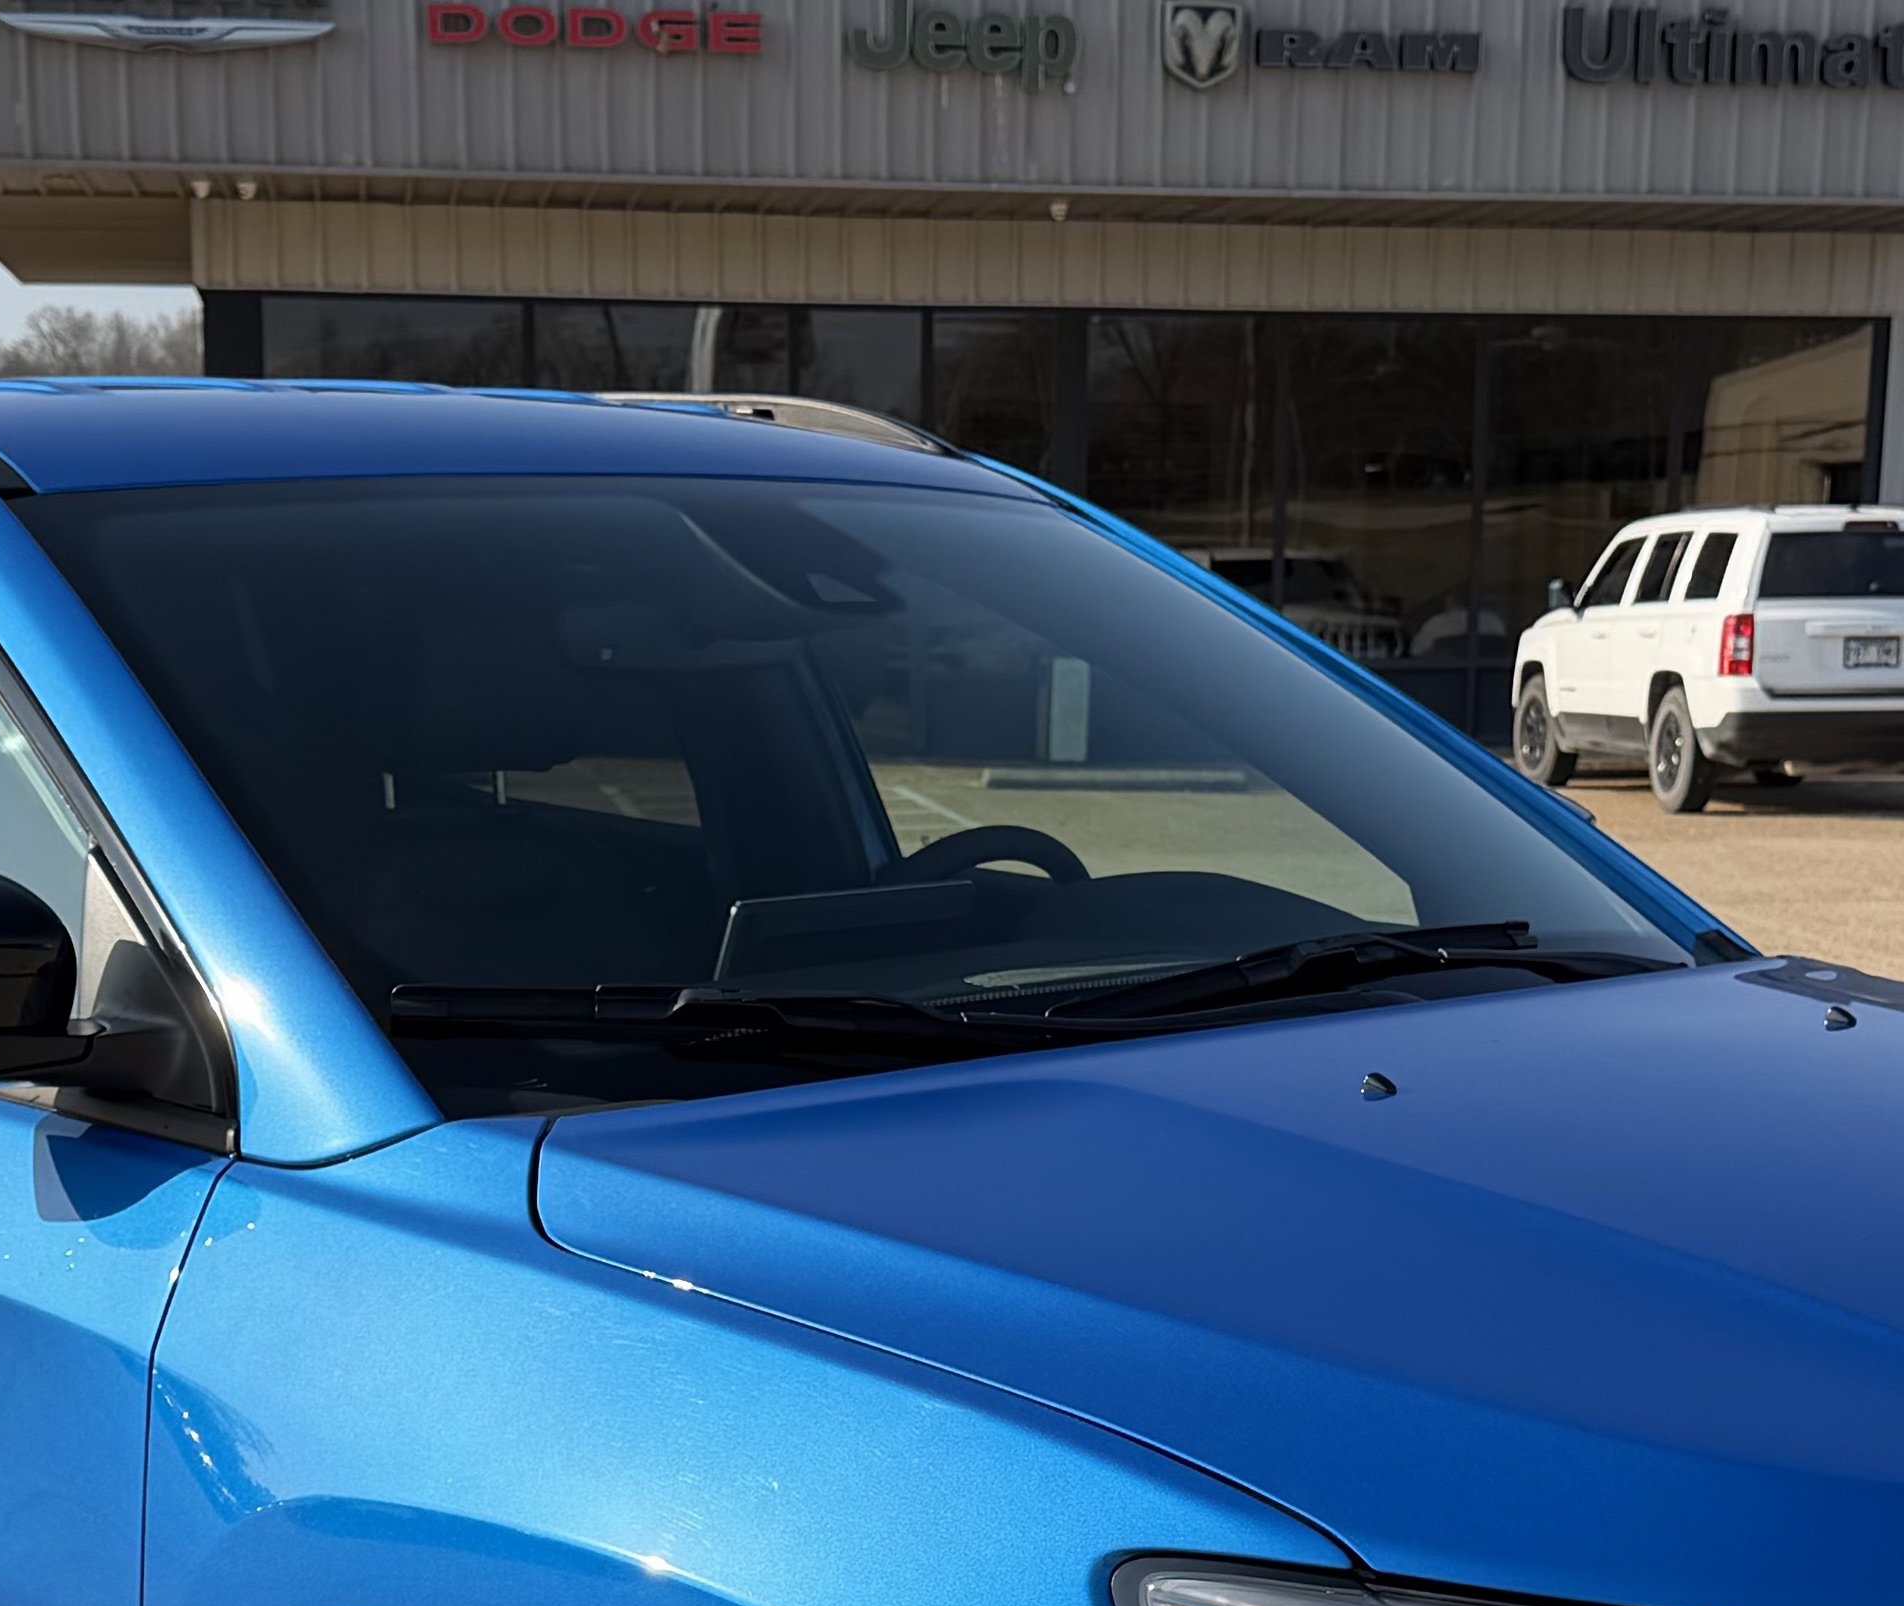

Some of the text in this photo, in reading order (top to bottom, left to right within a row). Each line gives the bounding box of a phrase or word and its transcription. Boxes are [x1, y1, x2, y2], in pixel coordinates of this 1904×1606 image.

[427, 4, 763, 54] DODGE
[847, 0, 1079, 94] Jeep
[1256, 28, 1483, 73] RAM
